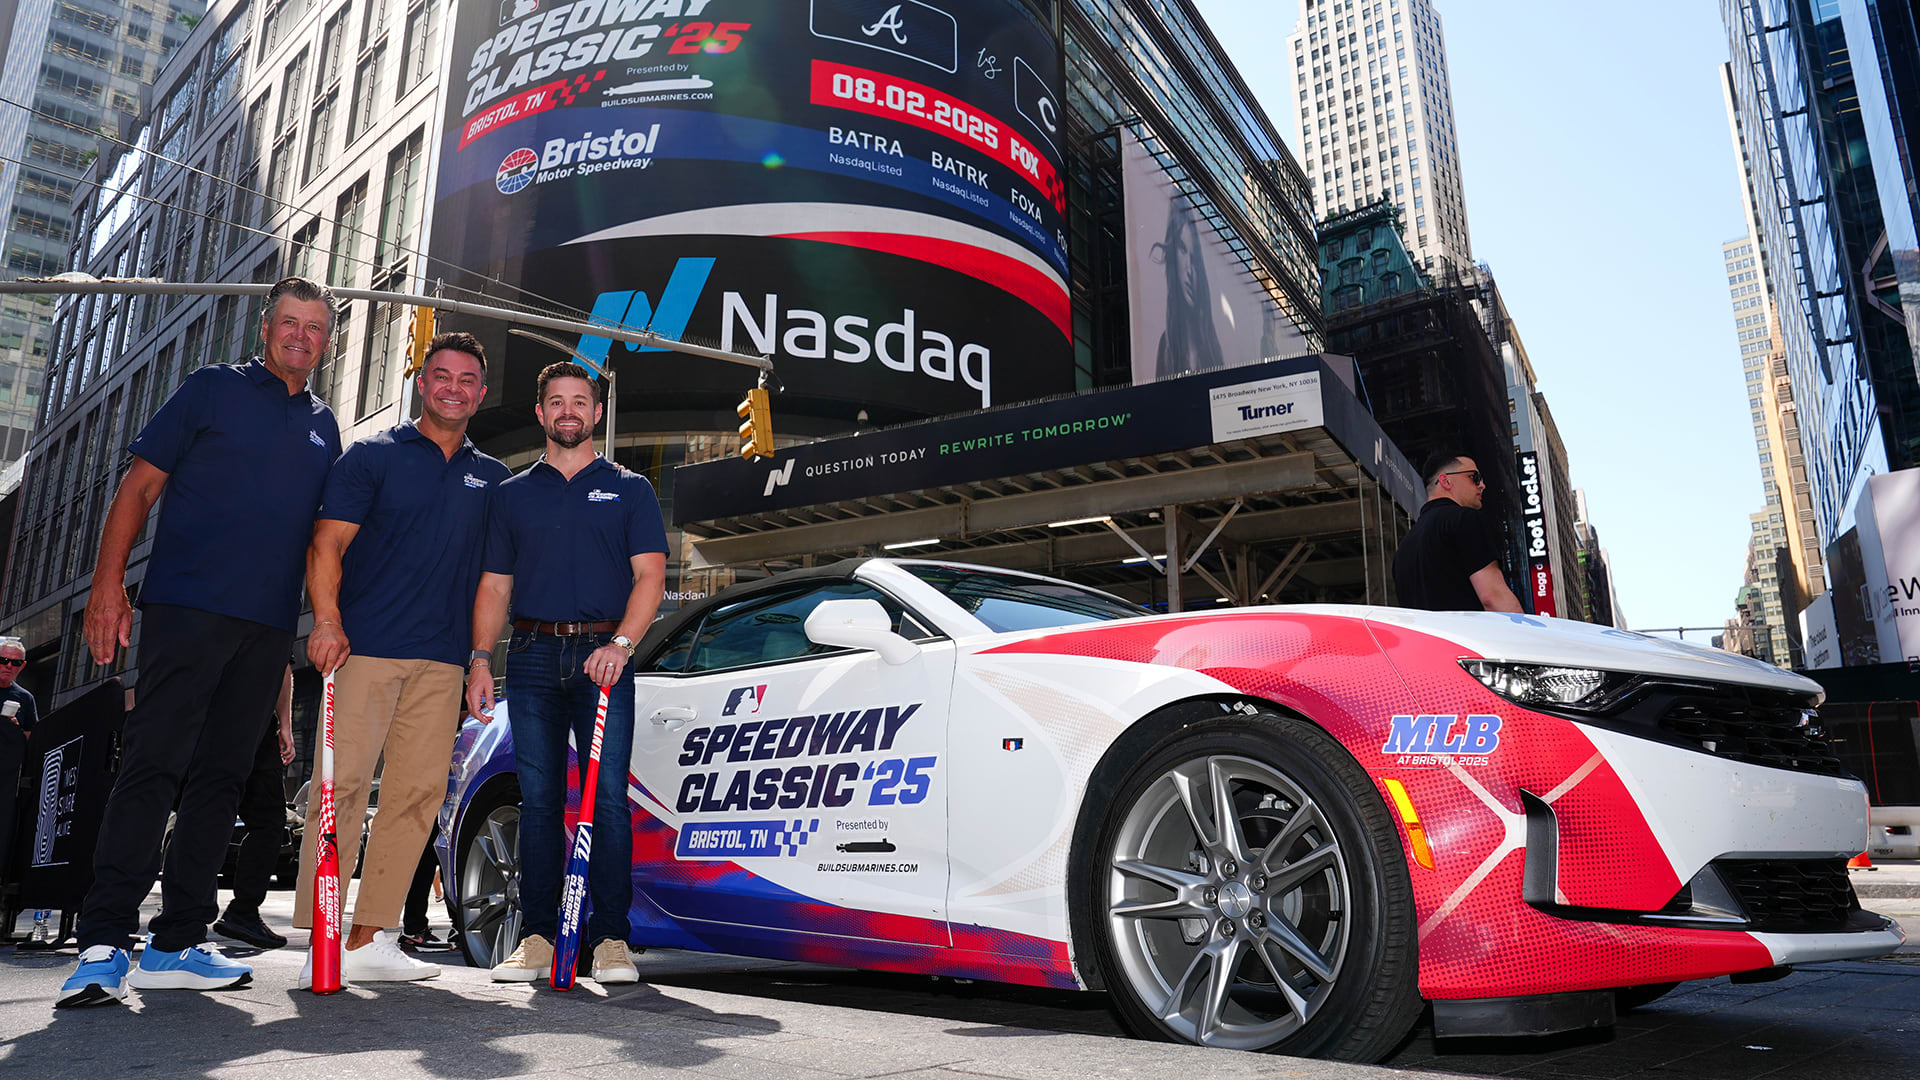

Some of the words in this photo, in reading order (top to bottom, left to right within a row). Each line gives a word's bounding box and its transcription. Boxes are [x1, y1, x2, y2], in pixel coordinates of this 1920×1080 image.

[467, 0, 710, 81] SPEEDWAY
[463, 24, 662, 118] CLASSIC
[627, 65, 675, 76] Presented
[676, 64, 689, 73] by
[467, 102, 521, 140] BRISTOL,
[525, 91, 547, 112] TN
[601, 92, 713, 108] BUILDSUBMARINES.COM
[832, 72, 999, 149] 08.02.2025
[539, 124, 660, 170] Bristol
[828, 126, 904, 158] BATRA
[1010, 136, 1040, 180] FOX
[536, 166, 574, 185] Motor
[577, 157, 651, 176] Speedway
[931, 151, 989, 190] BATRK
[1011, 187, 1043, 225] FOXA
[720, 290, 991, 409] Nasdaq
[1212, 393, 1227, 401] 1475
[1228, 388, 1257, 398] Broadway
[1273, 383, 1288, 391] York,
[1299, 377, 1318, 386] 10036
[1237, 402, 1294, 421] Turner
[805, 456, 875, 477] QUESTION
[880, 447, 927, 465] TODAY
[940, 432, 1014, 455] REWRITE
[1521, 456, 1541, 515] Locker
[1527, 517, 1546, 557] Foot
[678, 703, 923, 766] SPEEDWAY
[1382, 714, 1503, 755] MLB
[1397, 756, 1411, 765] AT
[1411, 756, 1457, 766] BRISTOL
[1458, 757, 1489, 766] 2025
[676, 762, 860, 813] CLASSIC
[689, 831, 746, 851] BRISTOL,
[750, 829, 768, 849] TN
[836, 819, 877, 831] Presented
[878, 819, 889, 832] by
[817, 863, 918, 873] BUILDSUBMARINES.COM
[326, 875, 334, 923] CLASSIC
[571, 875, 585, 934] SPEEDWAY
